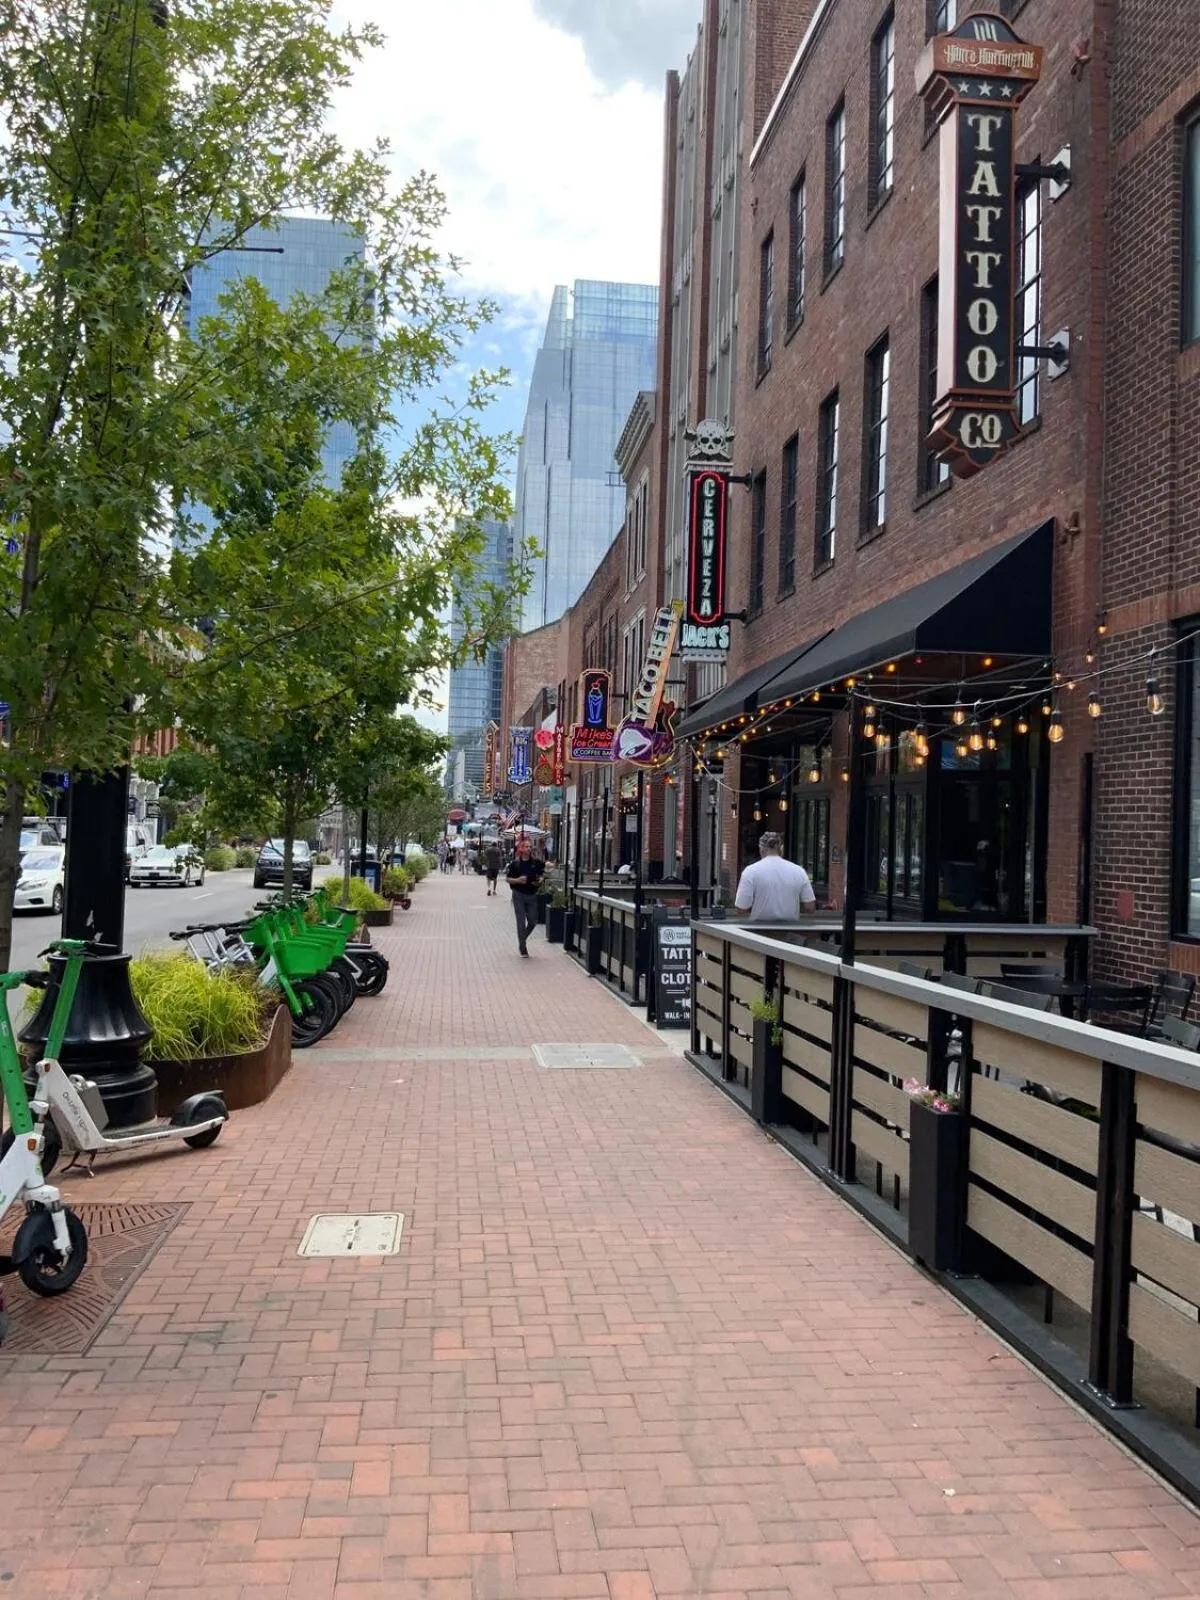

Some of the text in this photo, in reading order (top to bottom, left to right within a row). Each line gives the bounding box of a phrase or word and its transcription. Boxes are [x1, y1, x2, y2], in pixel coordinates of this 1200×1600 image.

[966, 114, 1002, 383] TATTOO
[960, 413, 1001, 448] CO
[701, 478, 715, 616] CERVEZA
[682, 623, 730, 650] JACK'S
[631, 664, 660, 722] TACO
[576, 728, 613, 740] Mike's
